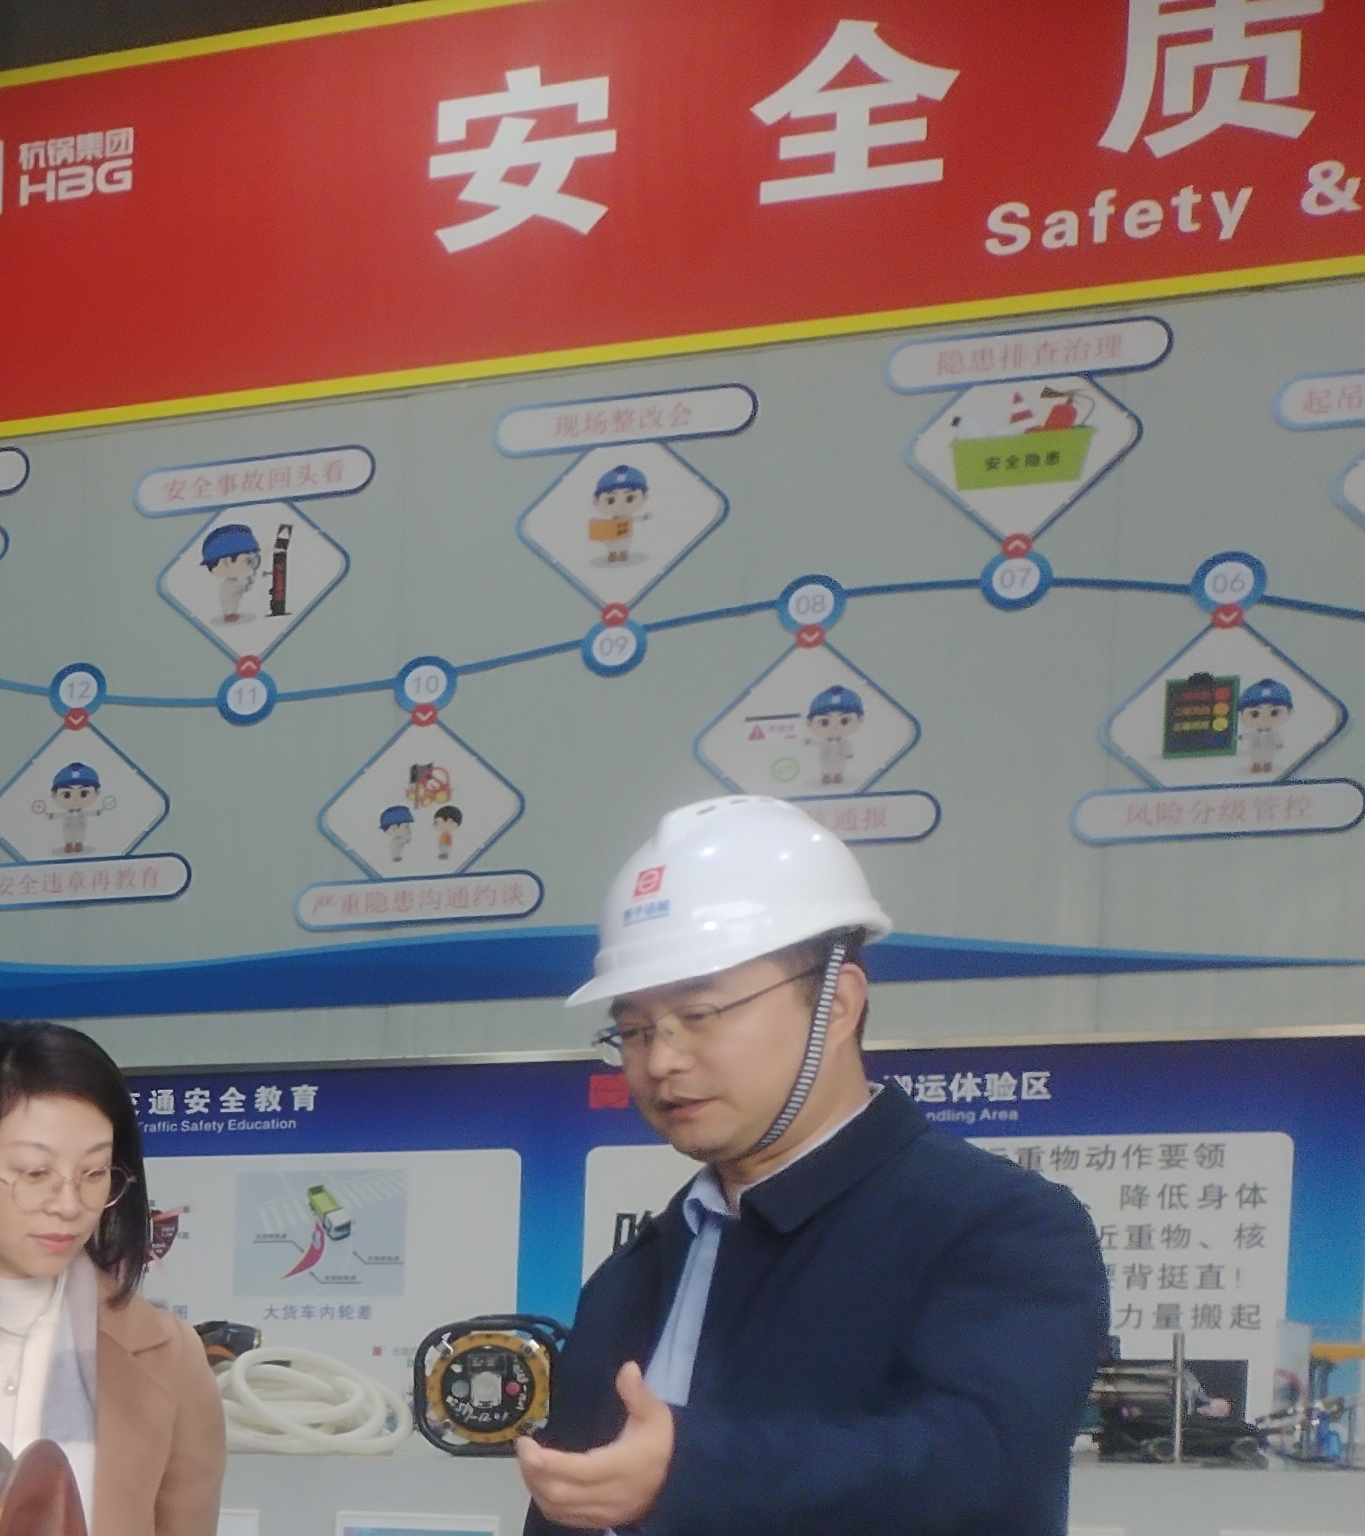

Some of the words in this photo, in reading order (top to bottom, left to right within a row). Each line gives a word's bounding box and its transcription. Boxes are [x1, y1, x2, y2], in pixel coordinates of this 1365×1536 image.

[19, 127, 134, 171] 杭锅集团
[19, 158, 134, 207] HBG
[985, 185, 1254, 256] Safety
[1300, 160, 1363, 216] &
[937, 333, 1124, 376] 隐患排查治理
[554, 401, 694, 438] 现场整改会
[984, 451, 1061, 472] 安全隐患
[162, 459, 345, 503] 安全事故回头看
[1000, 567, 1032, 589] 07
[1212, 571, 1247, 595] 06
[795, 594, 827, 615] 08
[599, 634, 629, 657] 09
[68, 681, 92, 700] 12
[236, 685, 258, 704] 11
[413, 674, 440, 694] 10
[1126, 794, 1313, 827] 风险分级管控
[312, 881, 525, 918] 严重隐患沟通约谈
[180, 1119, 224, 1133] Safety
[228, 1118, 297, 1131] Education
[925, 1109, 975, 1124] ndling
[979, 1108, 1019, 1121] Area
[262, 1304, 373, 1321] 大货车内轮差
[1114, 1303, 1262, 1331] 力量搬起
